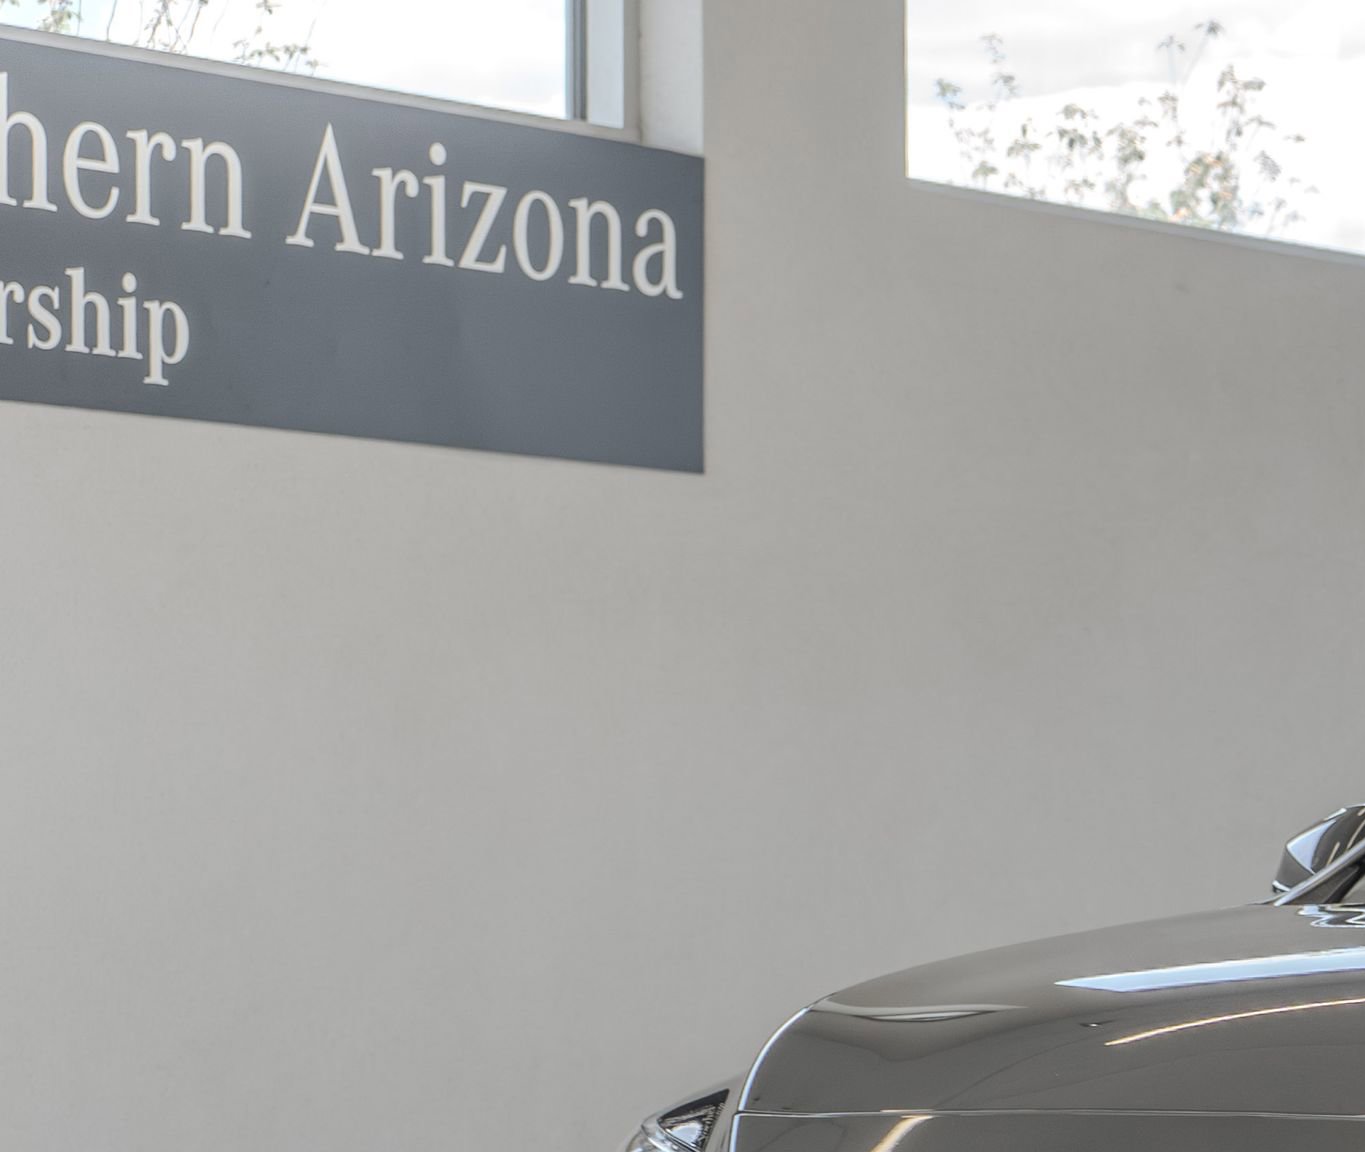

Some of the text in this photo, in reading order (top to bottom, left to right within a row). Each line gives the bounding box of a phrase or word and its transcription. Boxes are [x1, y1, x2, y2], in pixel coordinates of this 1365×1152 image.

[0, 72, 684, 300] hern Arizona
[0, 267, 190, 386] rship
